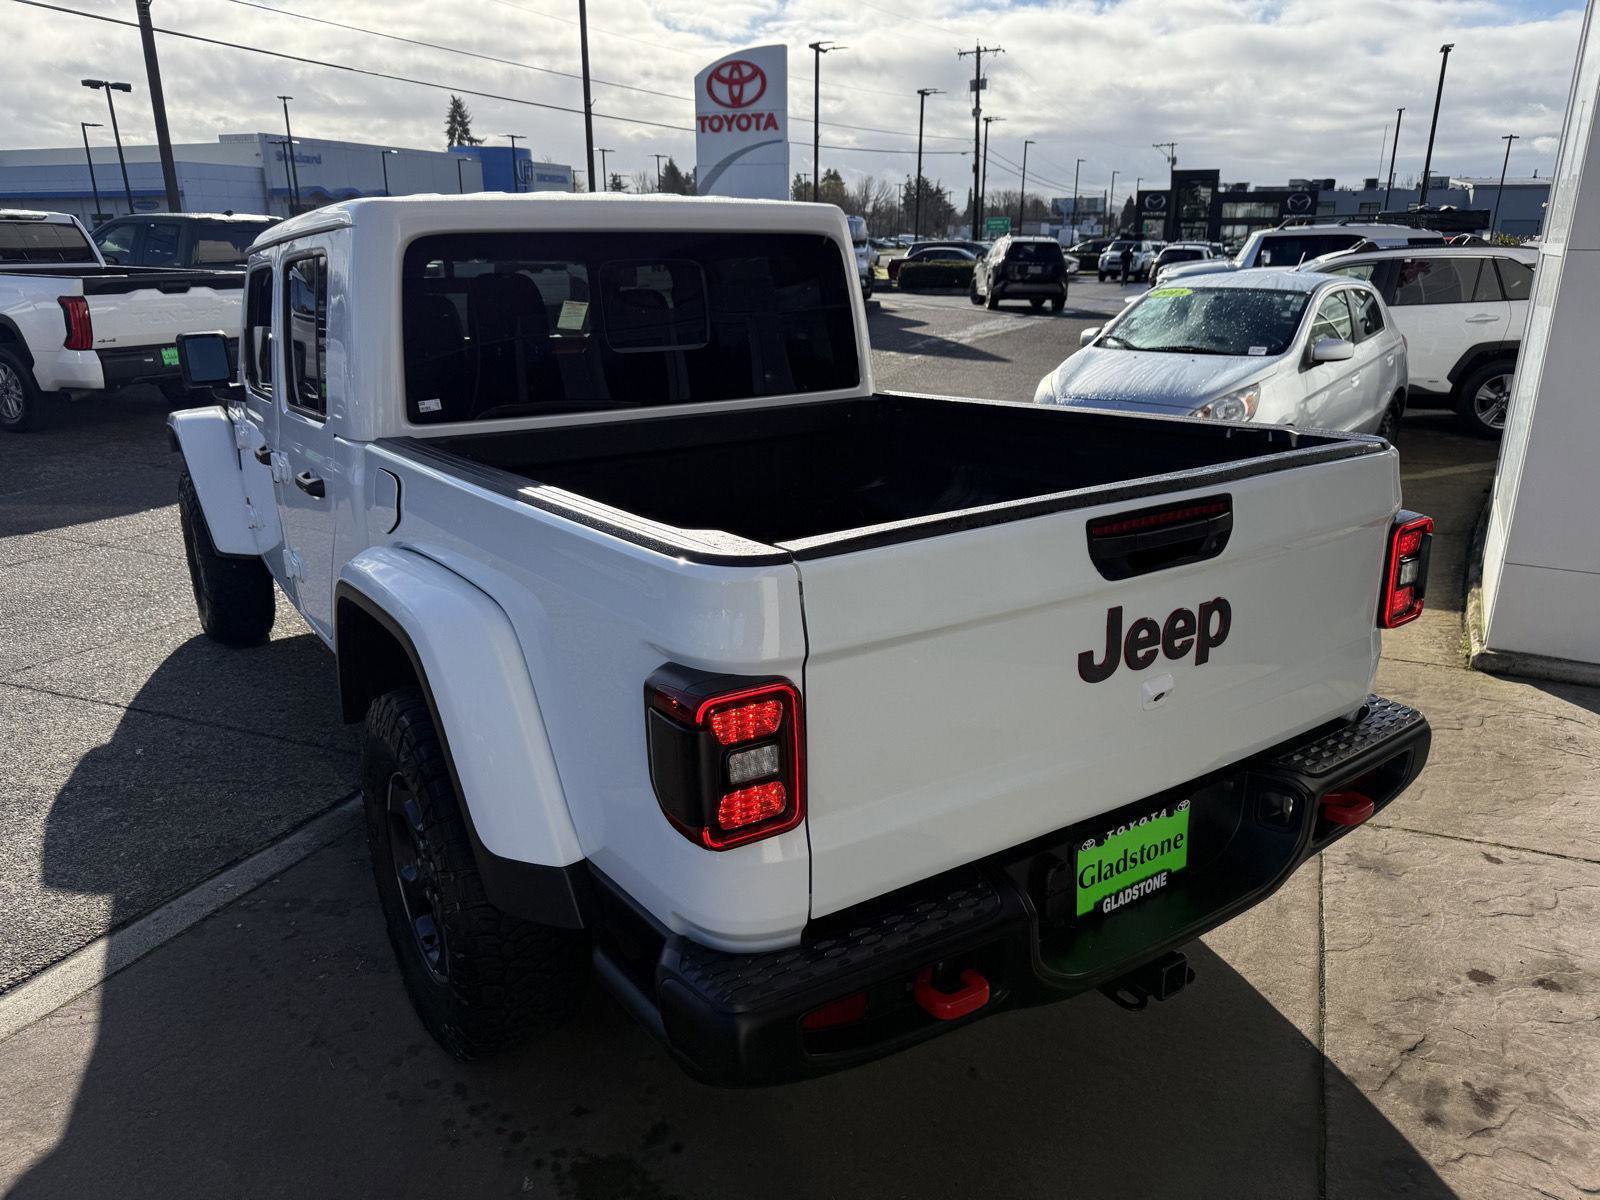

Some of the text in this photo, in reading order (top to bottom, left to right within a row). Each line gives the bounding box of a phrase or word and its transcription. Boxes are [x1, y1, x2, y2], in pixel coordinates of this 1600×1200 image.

[696, 112, 779, 133] TOYOTA
[1078, 596, 1232, 684] Jeep
[1106, 808, 1168, 840] TOYOTA
[1078, 833, 1184, 889] Gladstone
[1102, 872, 1168, 914] GLADSTONE
